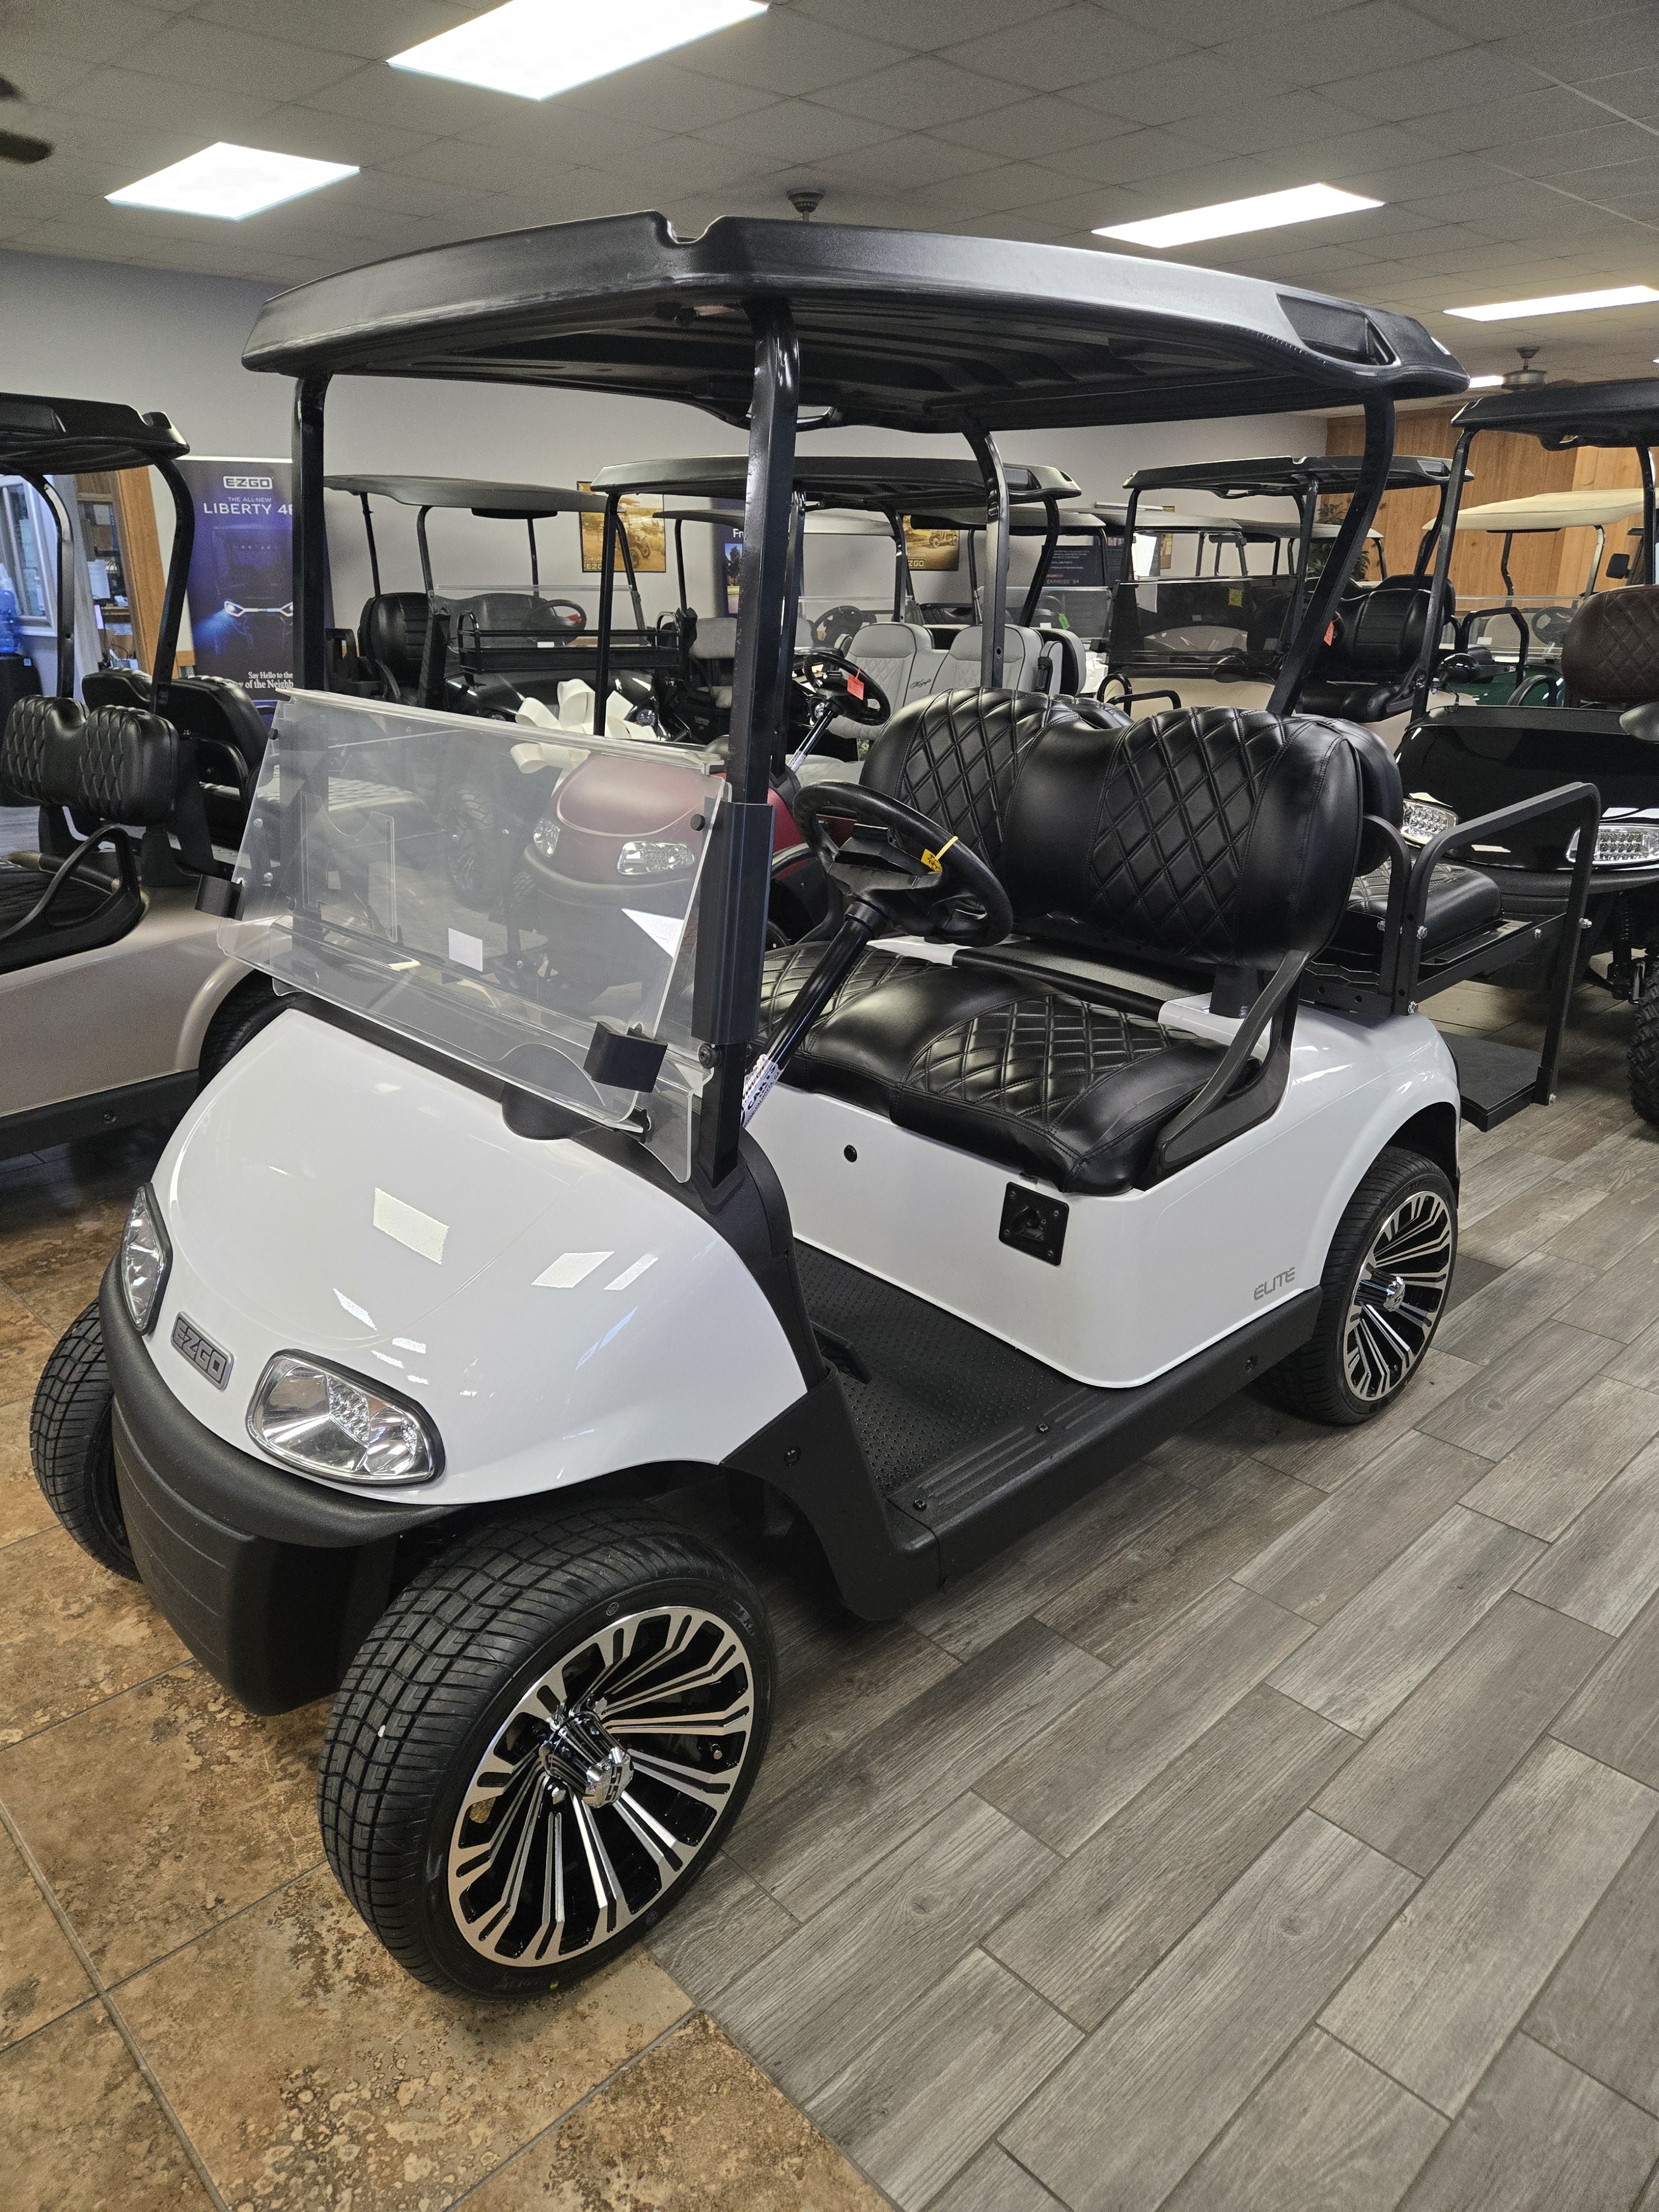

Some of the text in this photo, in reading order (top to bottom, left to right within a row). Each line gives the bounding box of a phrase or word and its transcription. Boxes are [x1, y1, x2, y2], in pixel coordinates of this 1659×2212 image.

[204, 503, 271, 514] LIBERTY
[260, 671, 276, 679] Hello
[245, 680, 253, 688] of
[254, 679, 266, 688] the
[267, 679, 294, 689] Neighb
[1254, 1266, 1295, 1301] ELITE
